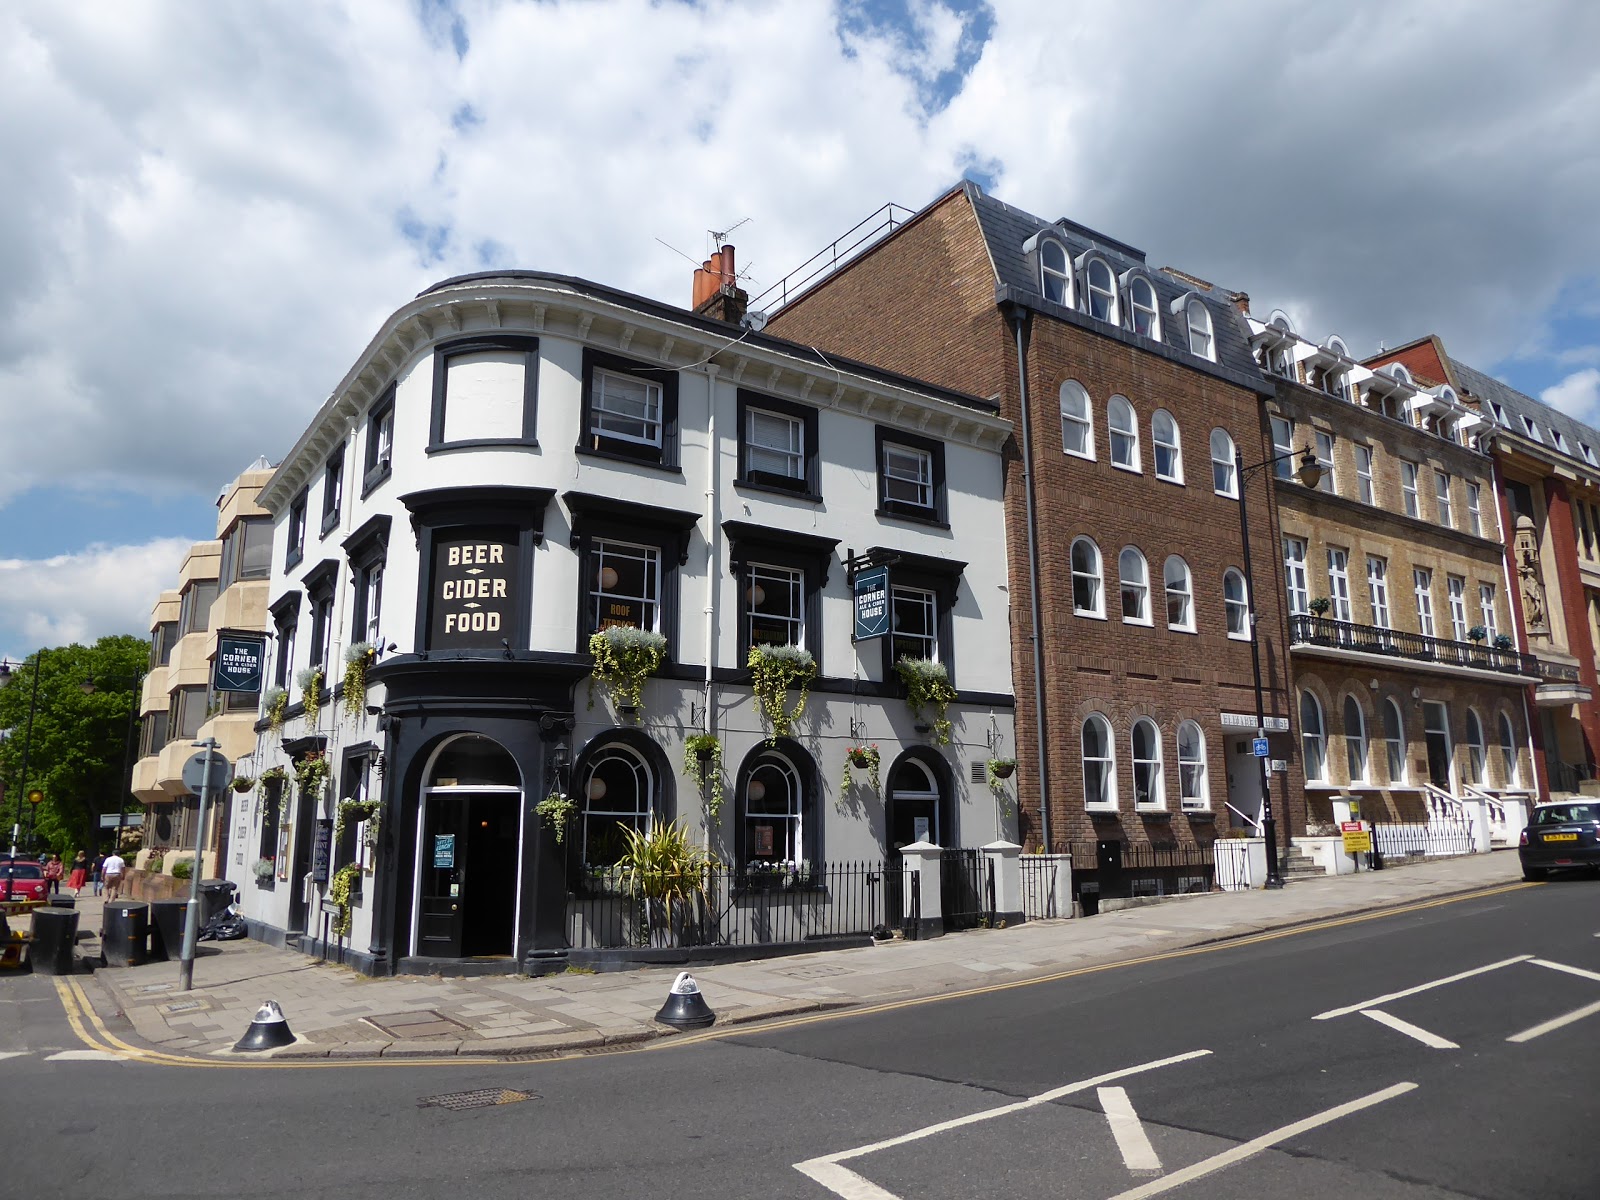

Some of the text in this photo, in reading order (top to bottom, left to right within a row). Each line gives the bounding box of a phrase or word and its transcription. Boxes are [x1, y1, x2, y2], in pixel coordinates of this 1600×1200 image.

[448, 545, 504, 566] BEER
[443, 578, 507, 600] CIDER
[867, 584, 876, 593] THE
[859, 590, 885, 604] CORNER
[610, 604, 630, 616] ROOF
[861, 606, 882, 619] HOUSE
[445, 612, 500, 633] FOOD
[223, 654, 257, 664] CORNER
[227, 666, 252, 674] HOUSE
[1223, 714, 1288, 729] ELIZABET HOUSE
